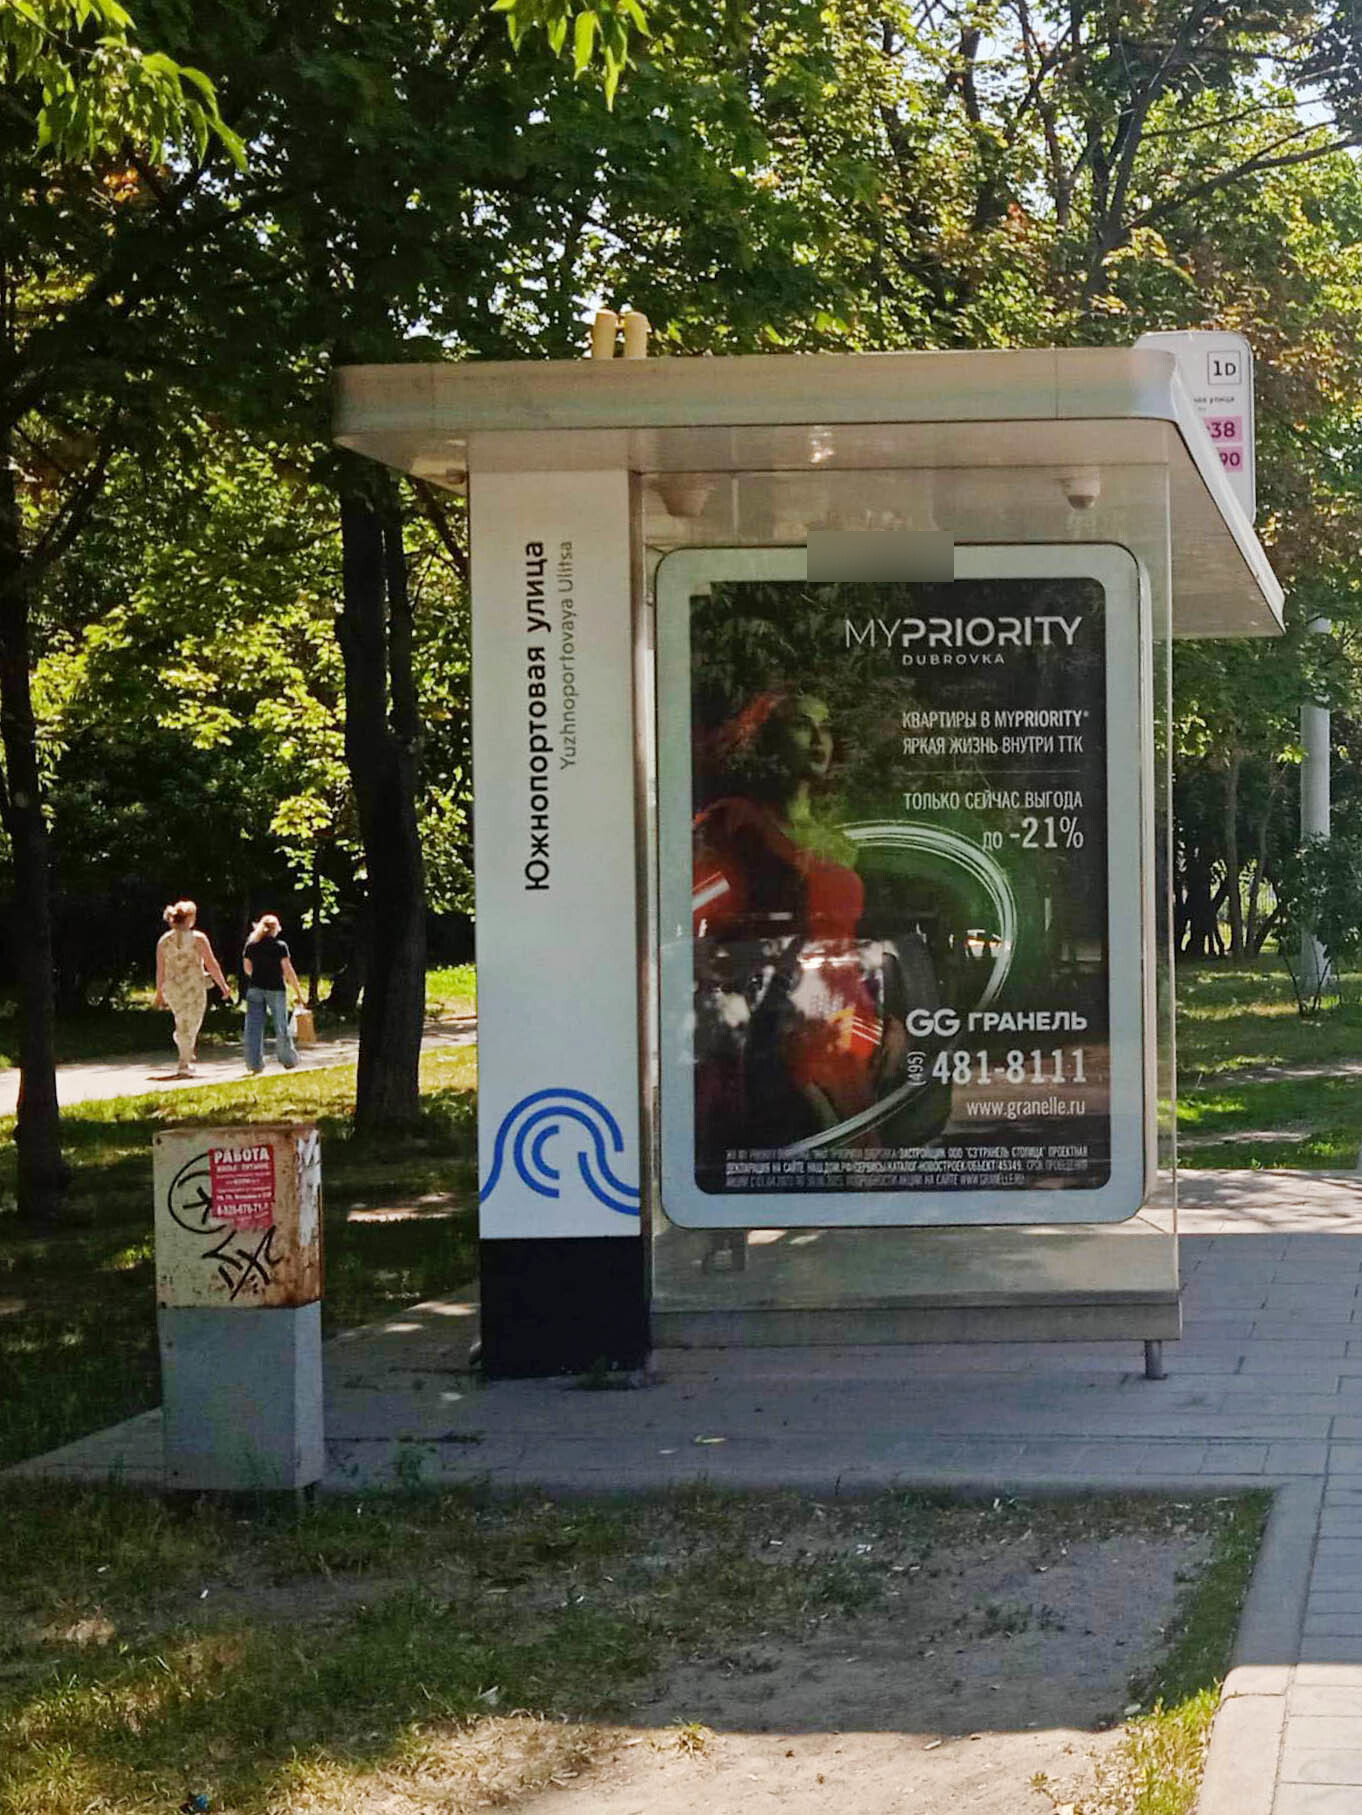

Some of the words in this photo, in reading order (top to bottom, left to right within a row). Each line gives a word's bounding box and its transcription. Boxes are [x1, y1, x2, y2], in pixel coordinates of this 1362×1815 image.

[1207, 421, 1236, 438] 38
[557, 541, 574, 592] Ulitsa
[525, 541, 552, 633] улица
[845, 615, 1083, 648] MYPRIORITY
[902, 653, 1006, 666] DUBROVKA
[560, 599, 577, 770] Yuzhnoportovaya
[902, 711, 976, 729] КВАРТИРЫ
[980, 711, 991, 728] В
[903, 737, 946, 755] ЯРКАЯ
[949, 736, 999, 754] ЖИЗНЬ
[1002, 735, 1054, 754] ВНУТРИ
[1058, 735, 1084, 753] ТТК
[525, 647, 553, 891] Южнопортовая
[904, 792, 960, 810] ТОЛЬКО
[964, 789, 1020, 809] СЕЙЧАС
[1024, 790, 1084, 810] ВЫГОДА
[1009, 815, 1085, 849] -21%
[967, 1011, 1088, 1032] ГРАНЕЛЬ
[906, 1051, 927, 1087] (495)
[931, 1048, 1087, 1086] 481-8111
[966, 1096, 1086, 1120] www.granelle.ru
[214, 1147, 270, 1164] РАБОТА
